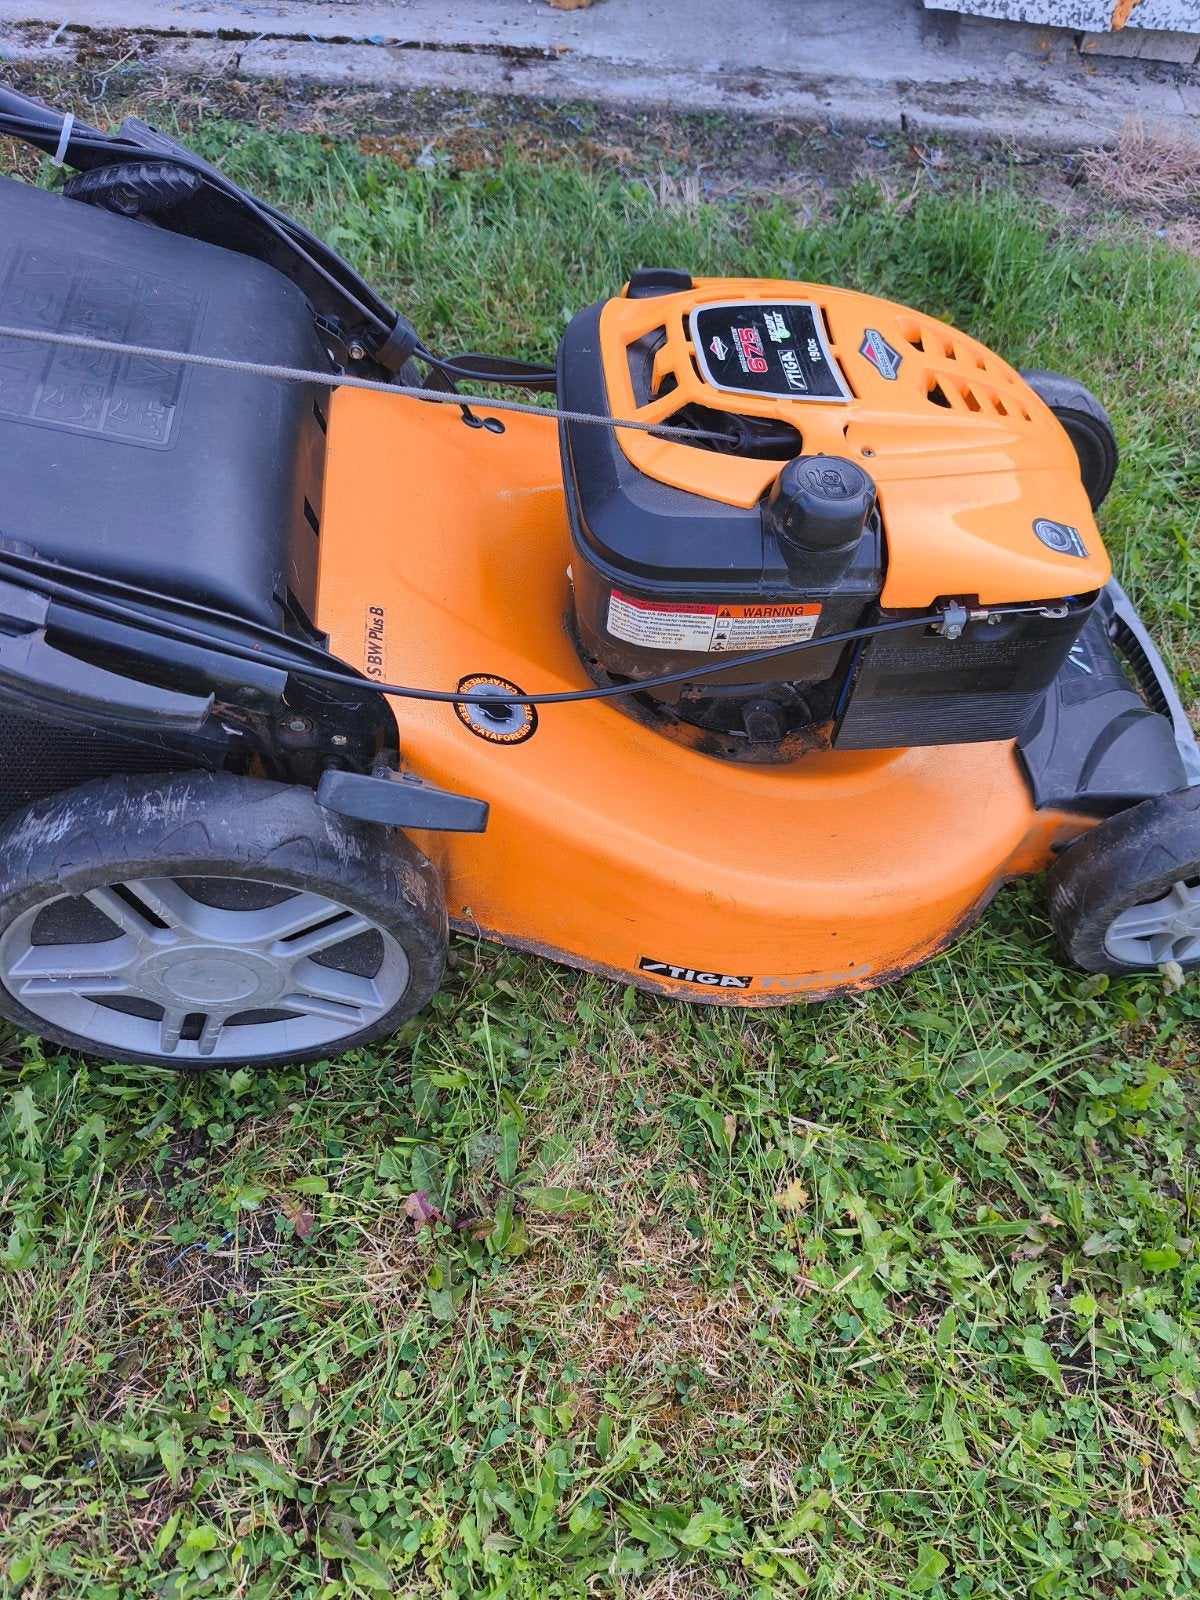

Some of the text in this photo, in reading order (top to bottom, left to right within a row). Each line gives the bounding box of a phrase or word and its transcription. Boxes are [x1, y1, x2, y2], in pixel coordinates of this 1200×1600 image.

[738, 328, 768, 373] 675
[807, 338, 822, 362] 190cc
[781, 351, 806, 390] STIGA
[369, 606, 384, 617] B
[744, 606, 804, 617] WARNING
[369, 617, 384, 641] Plus
[368, 641, 382, 666] BW
[459, 677, 518, 695] CATAFORESIS
[472, 723, 531, 741] CATAFORESIS
[643, 963, 747, 988] STIGA
